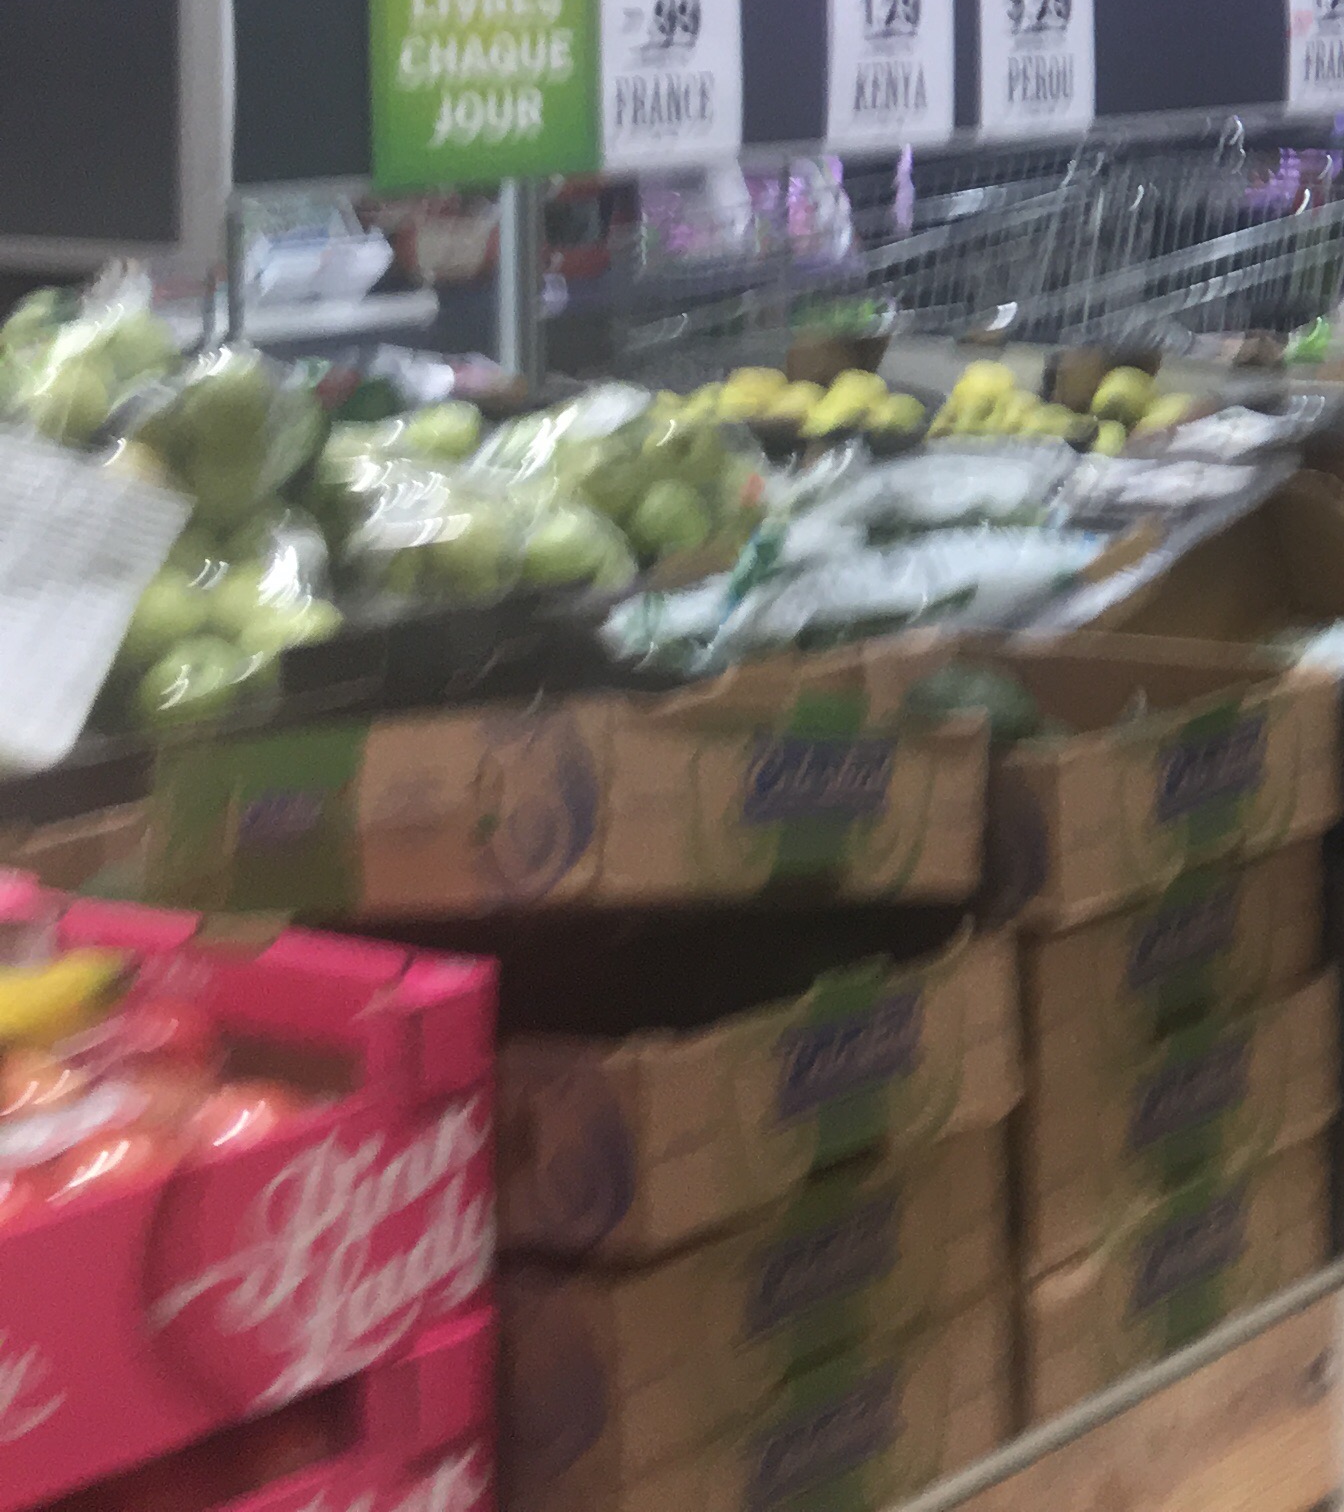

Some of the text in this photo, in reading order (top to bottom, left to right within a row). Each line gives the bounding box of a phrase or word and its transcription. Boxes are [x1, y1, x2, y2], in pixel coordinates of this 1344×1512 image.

[398, 30, 575, 90] CHAQUE
[852, 61, 928, 113] KENYA
[429, 86, 544, 148] JOUR
[614, 71, 715, 128] FRANCE
